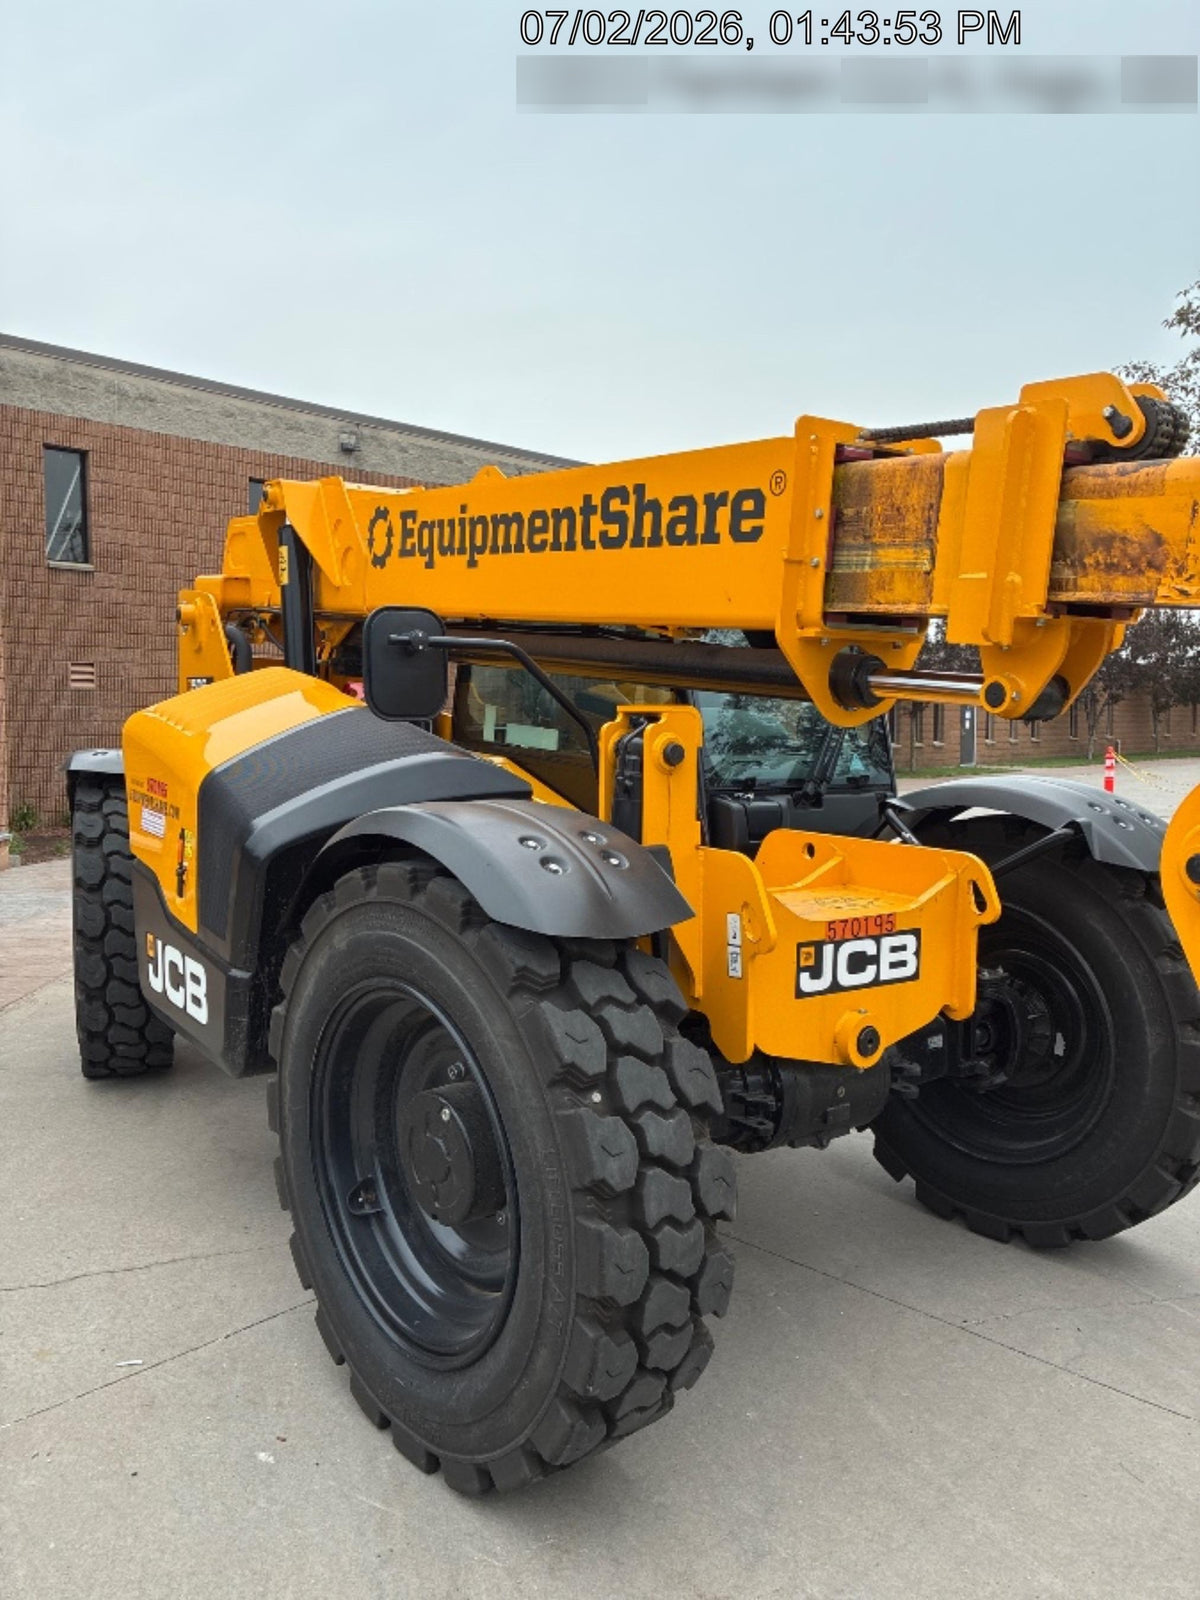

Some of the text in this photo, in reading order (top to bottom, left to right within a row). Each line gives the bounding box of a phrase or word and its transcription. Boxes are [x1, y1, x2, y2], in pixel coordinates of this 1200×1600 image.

[828, 913, 893, 940] 570195
[148, 938, 208, 1025] JCB
[800, 934, 918, 993] JCB
